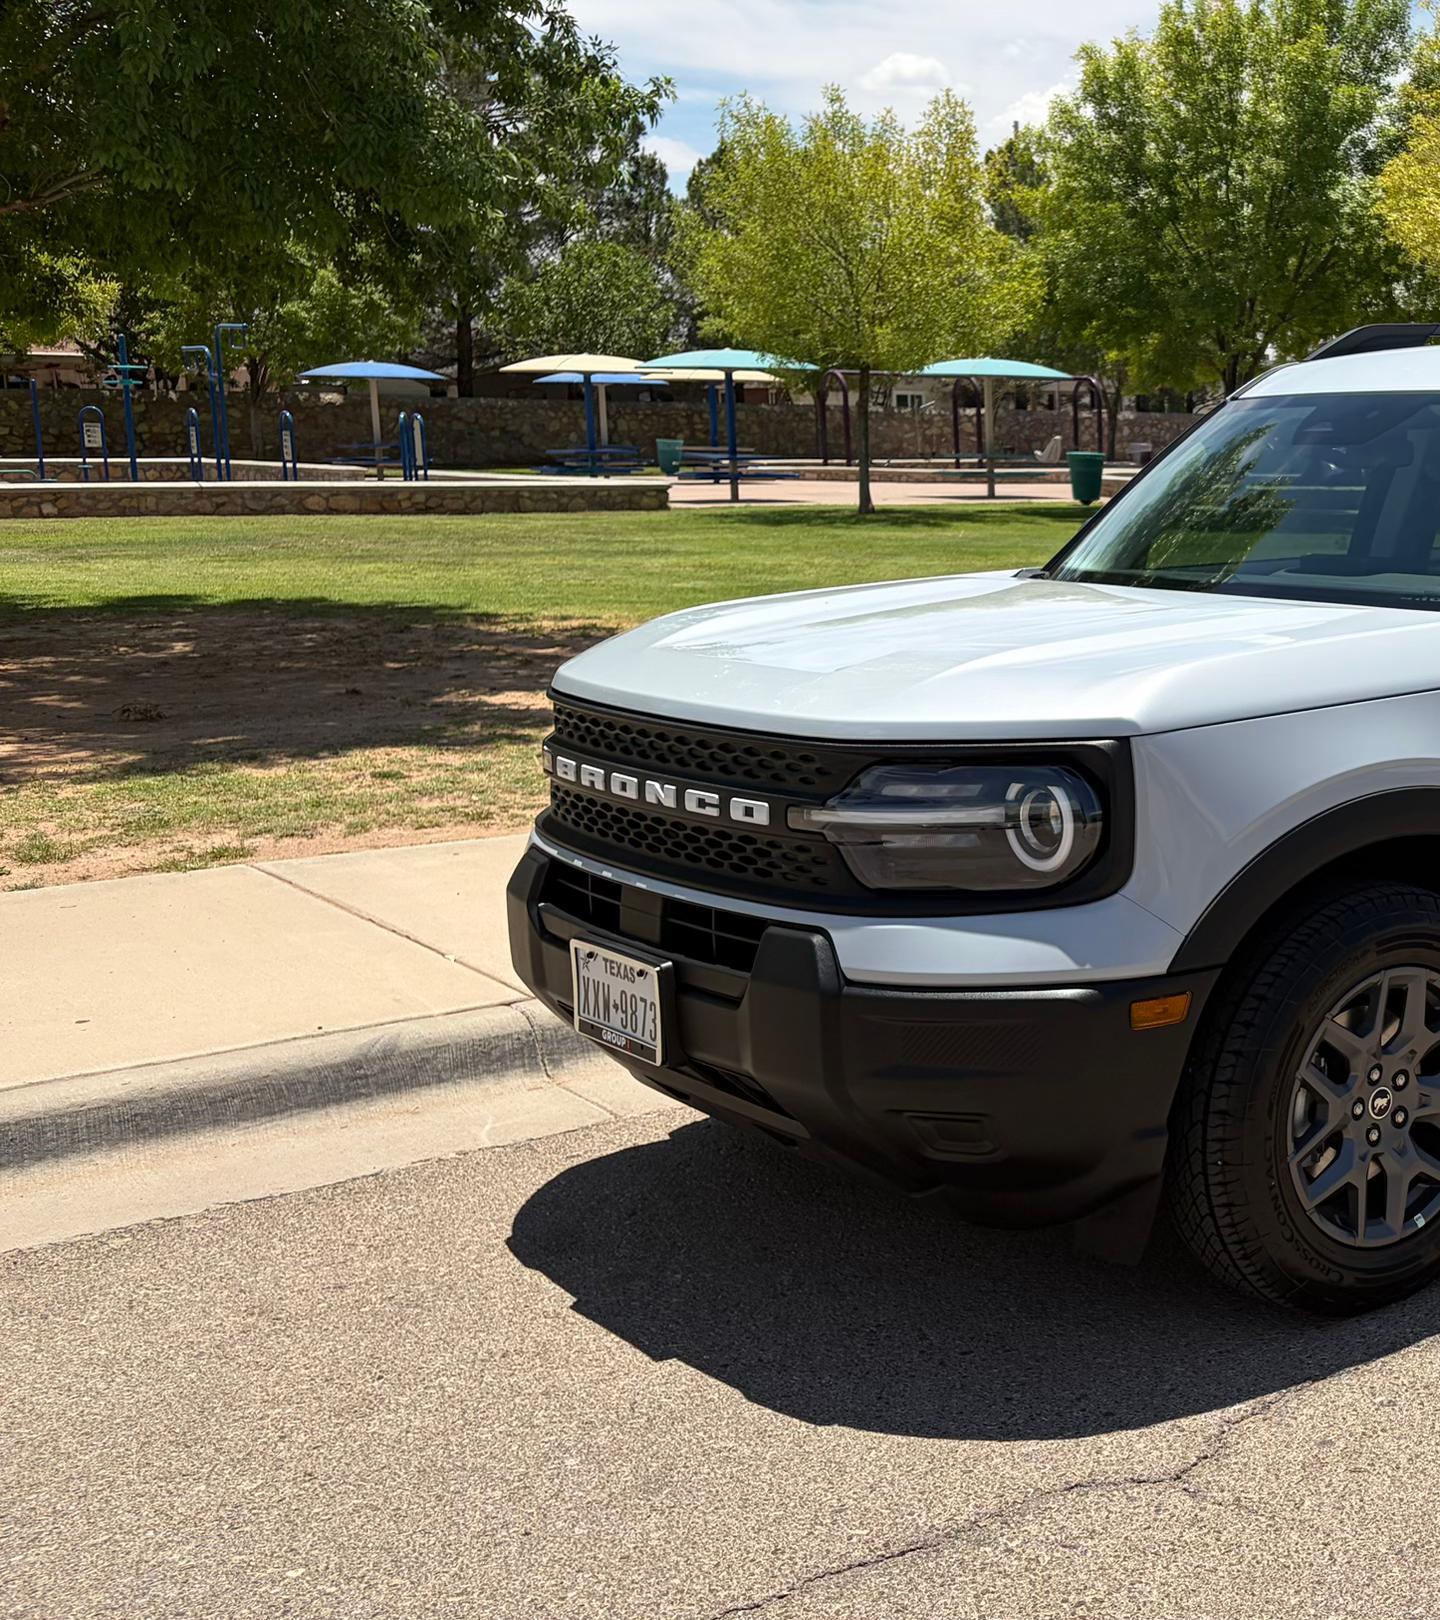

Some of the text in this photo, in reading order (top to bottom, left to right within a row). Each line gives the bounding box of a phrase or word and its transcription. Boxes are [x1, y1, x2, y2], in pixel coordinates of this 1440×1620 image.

[556, 756, 770, 826] BRONCO
[603, 958, 636, 984] TEXAS
[602, 1030, 626, 1047] GROUP
